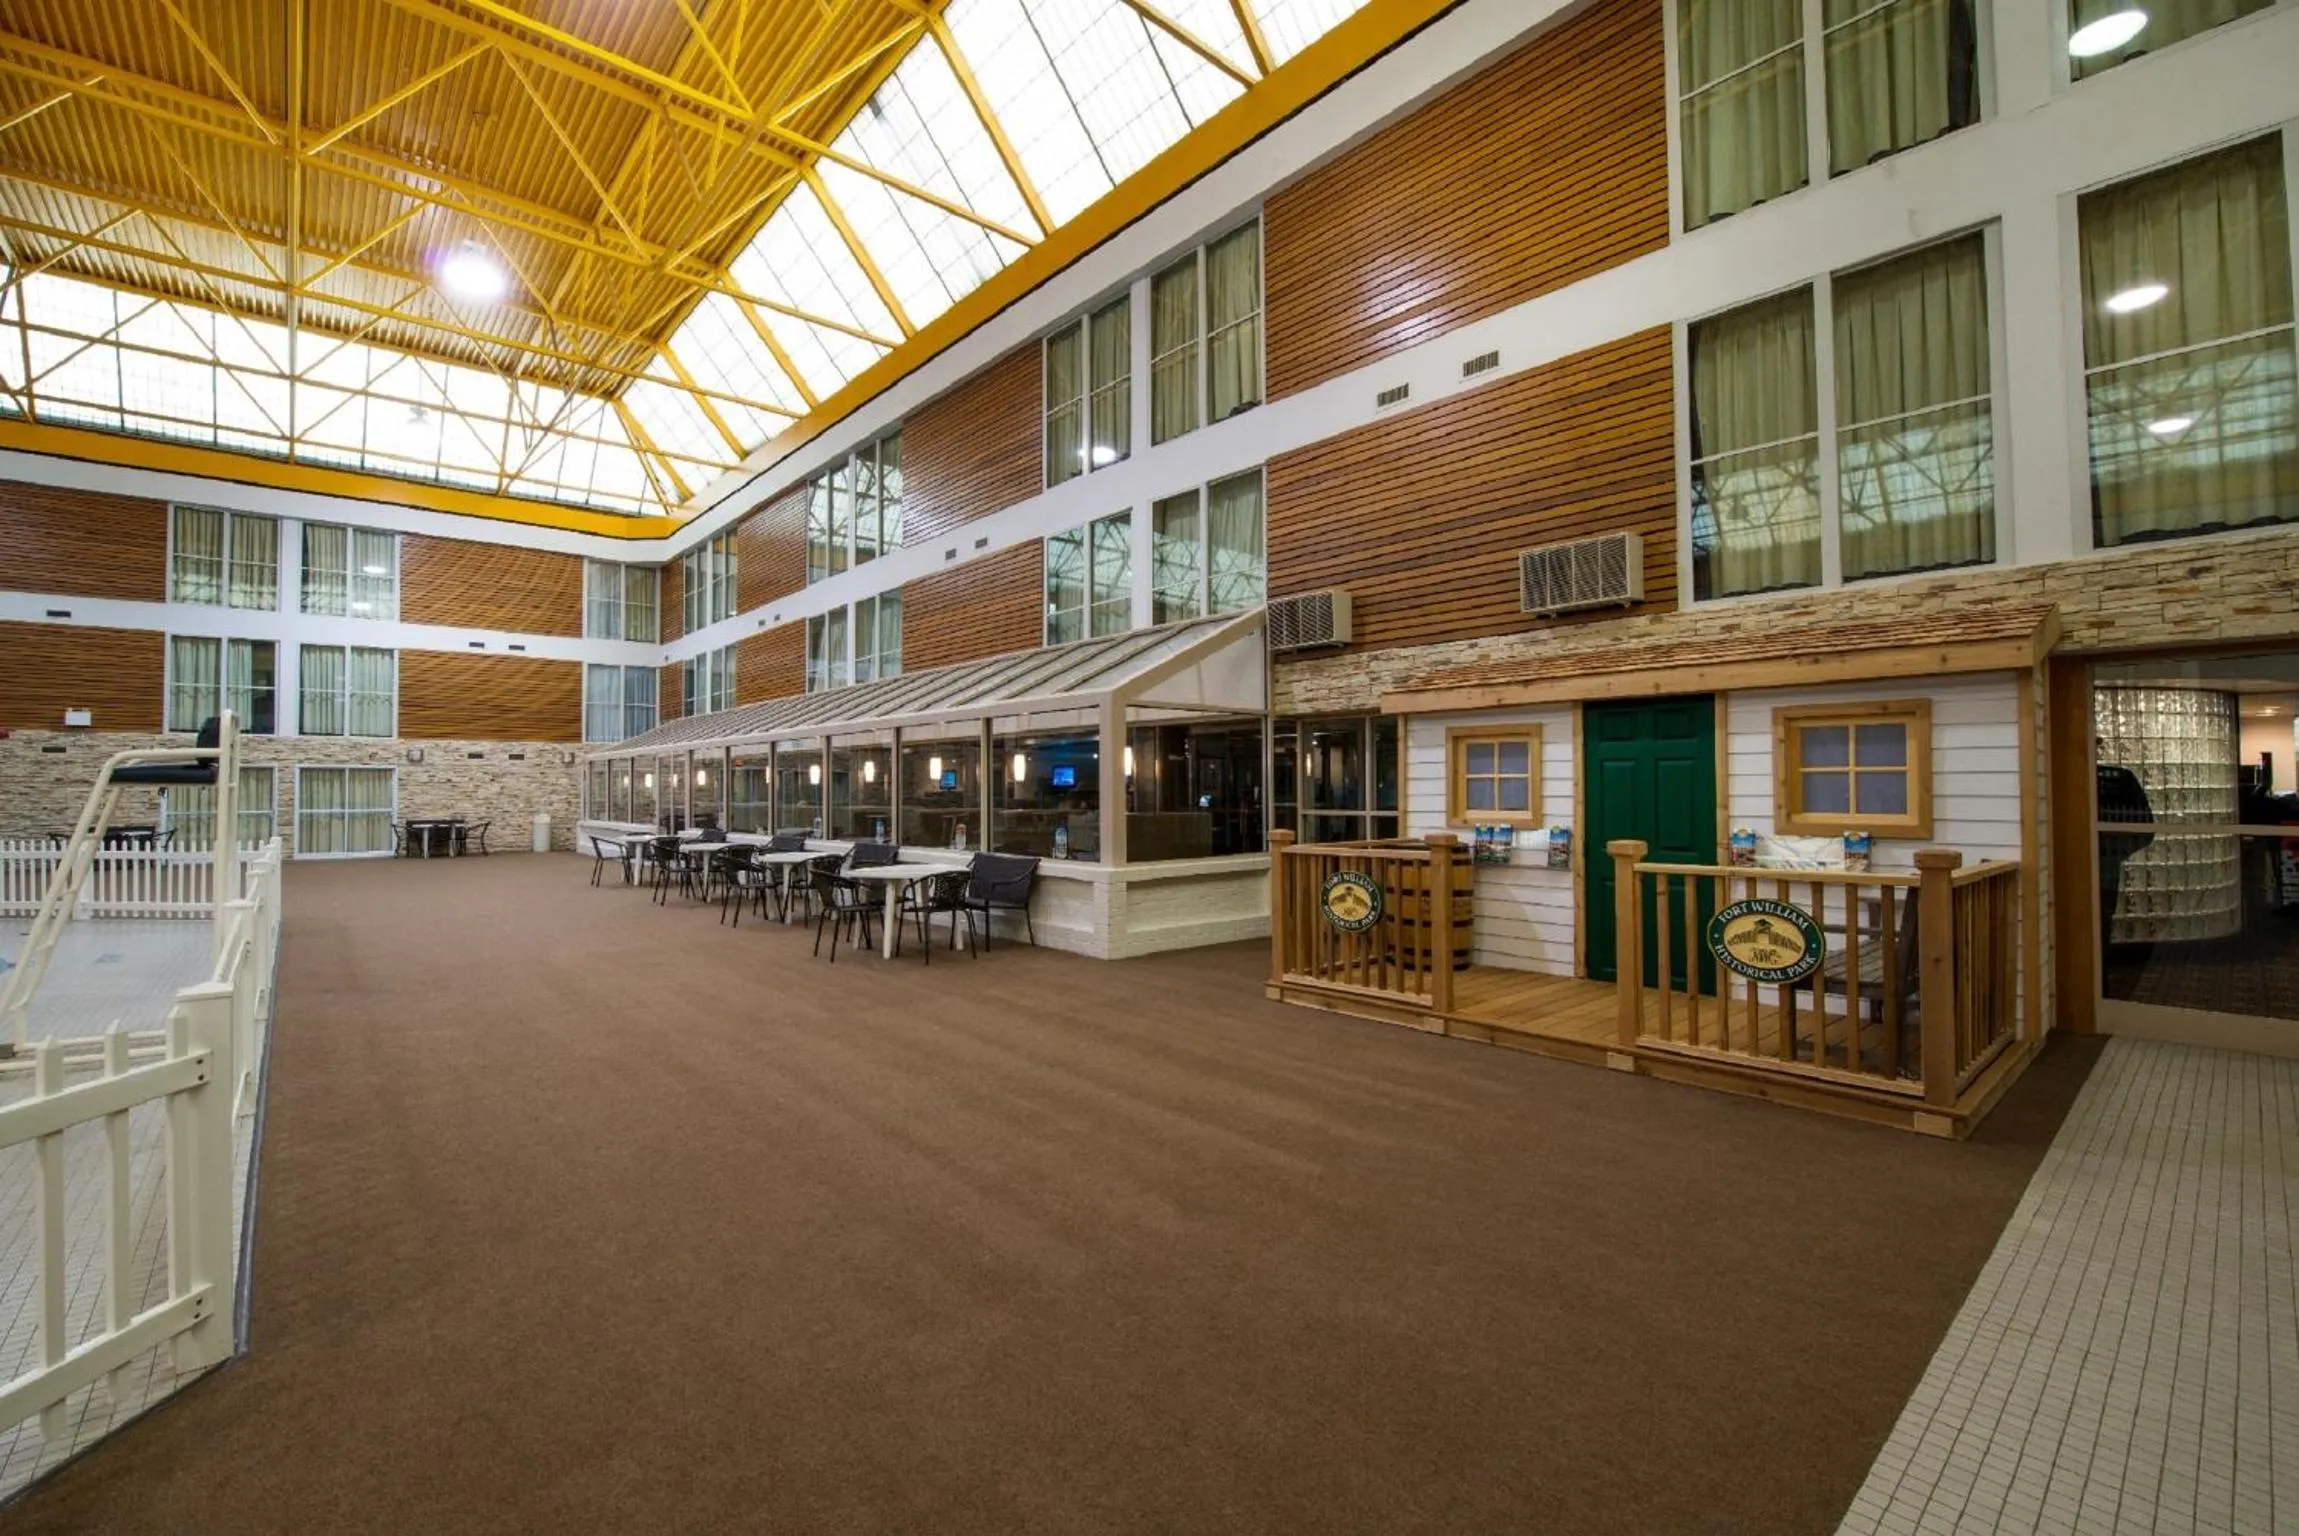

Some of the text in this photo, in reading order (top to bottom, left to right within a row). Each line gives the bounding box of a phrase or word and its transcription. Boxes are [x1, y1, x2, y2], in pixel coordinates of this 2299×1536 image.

[1718, 901, 1809, 929] FORT WILLIAM
[1714, 944, 1816, 979] HISTORICAL PARK
